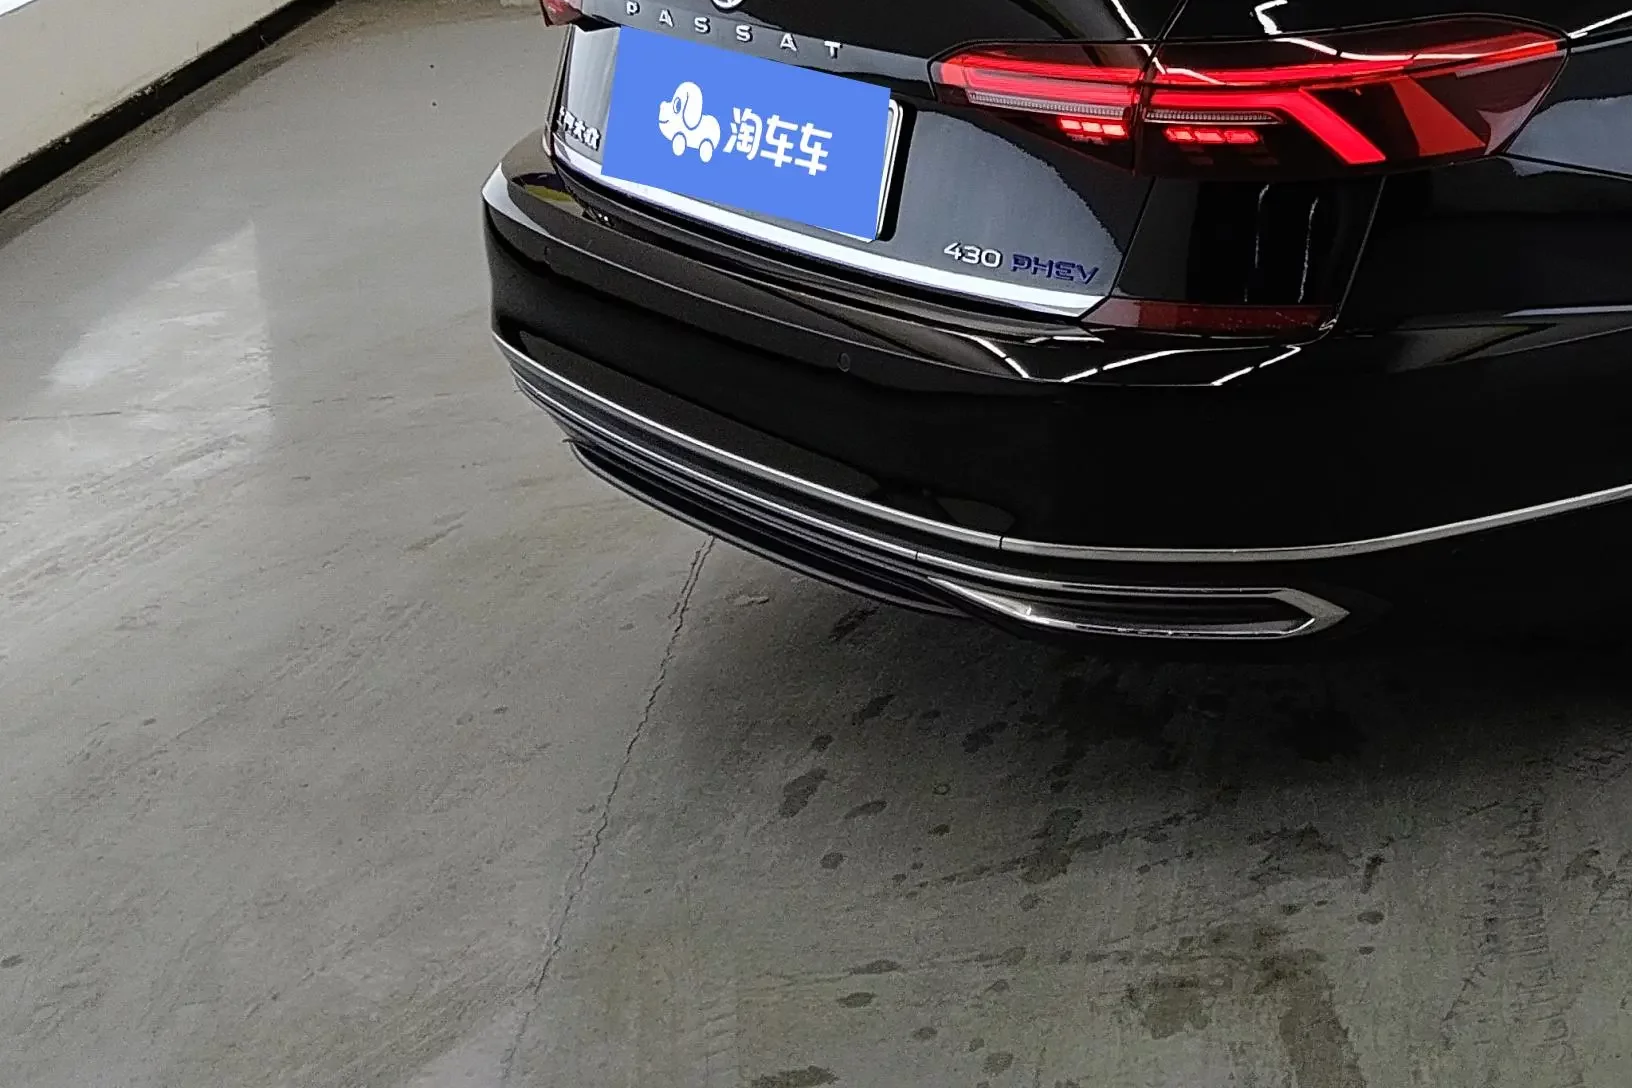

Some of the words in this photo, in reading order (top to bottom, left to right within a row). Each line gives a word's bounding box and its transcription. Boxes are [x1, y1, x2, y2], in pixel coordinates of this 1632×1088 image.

[626, 0, 843, 58] PASSAT
[943, 241, 1002, 269] 430
[1010, 253, 1099, 285] PHEV
